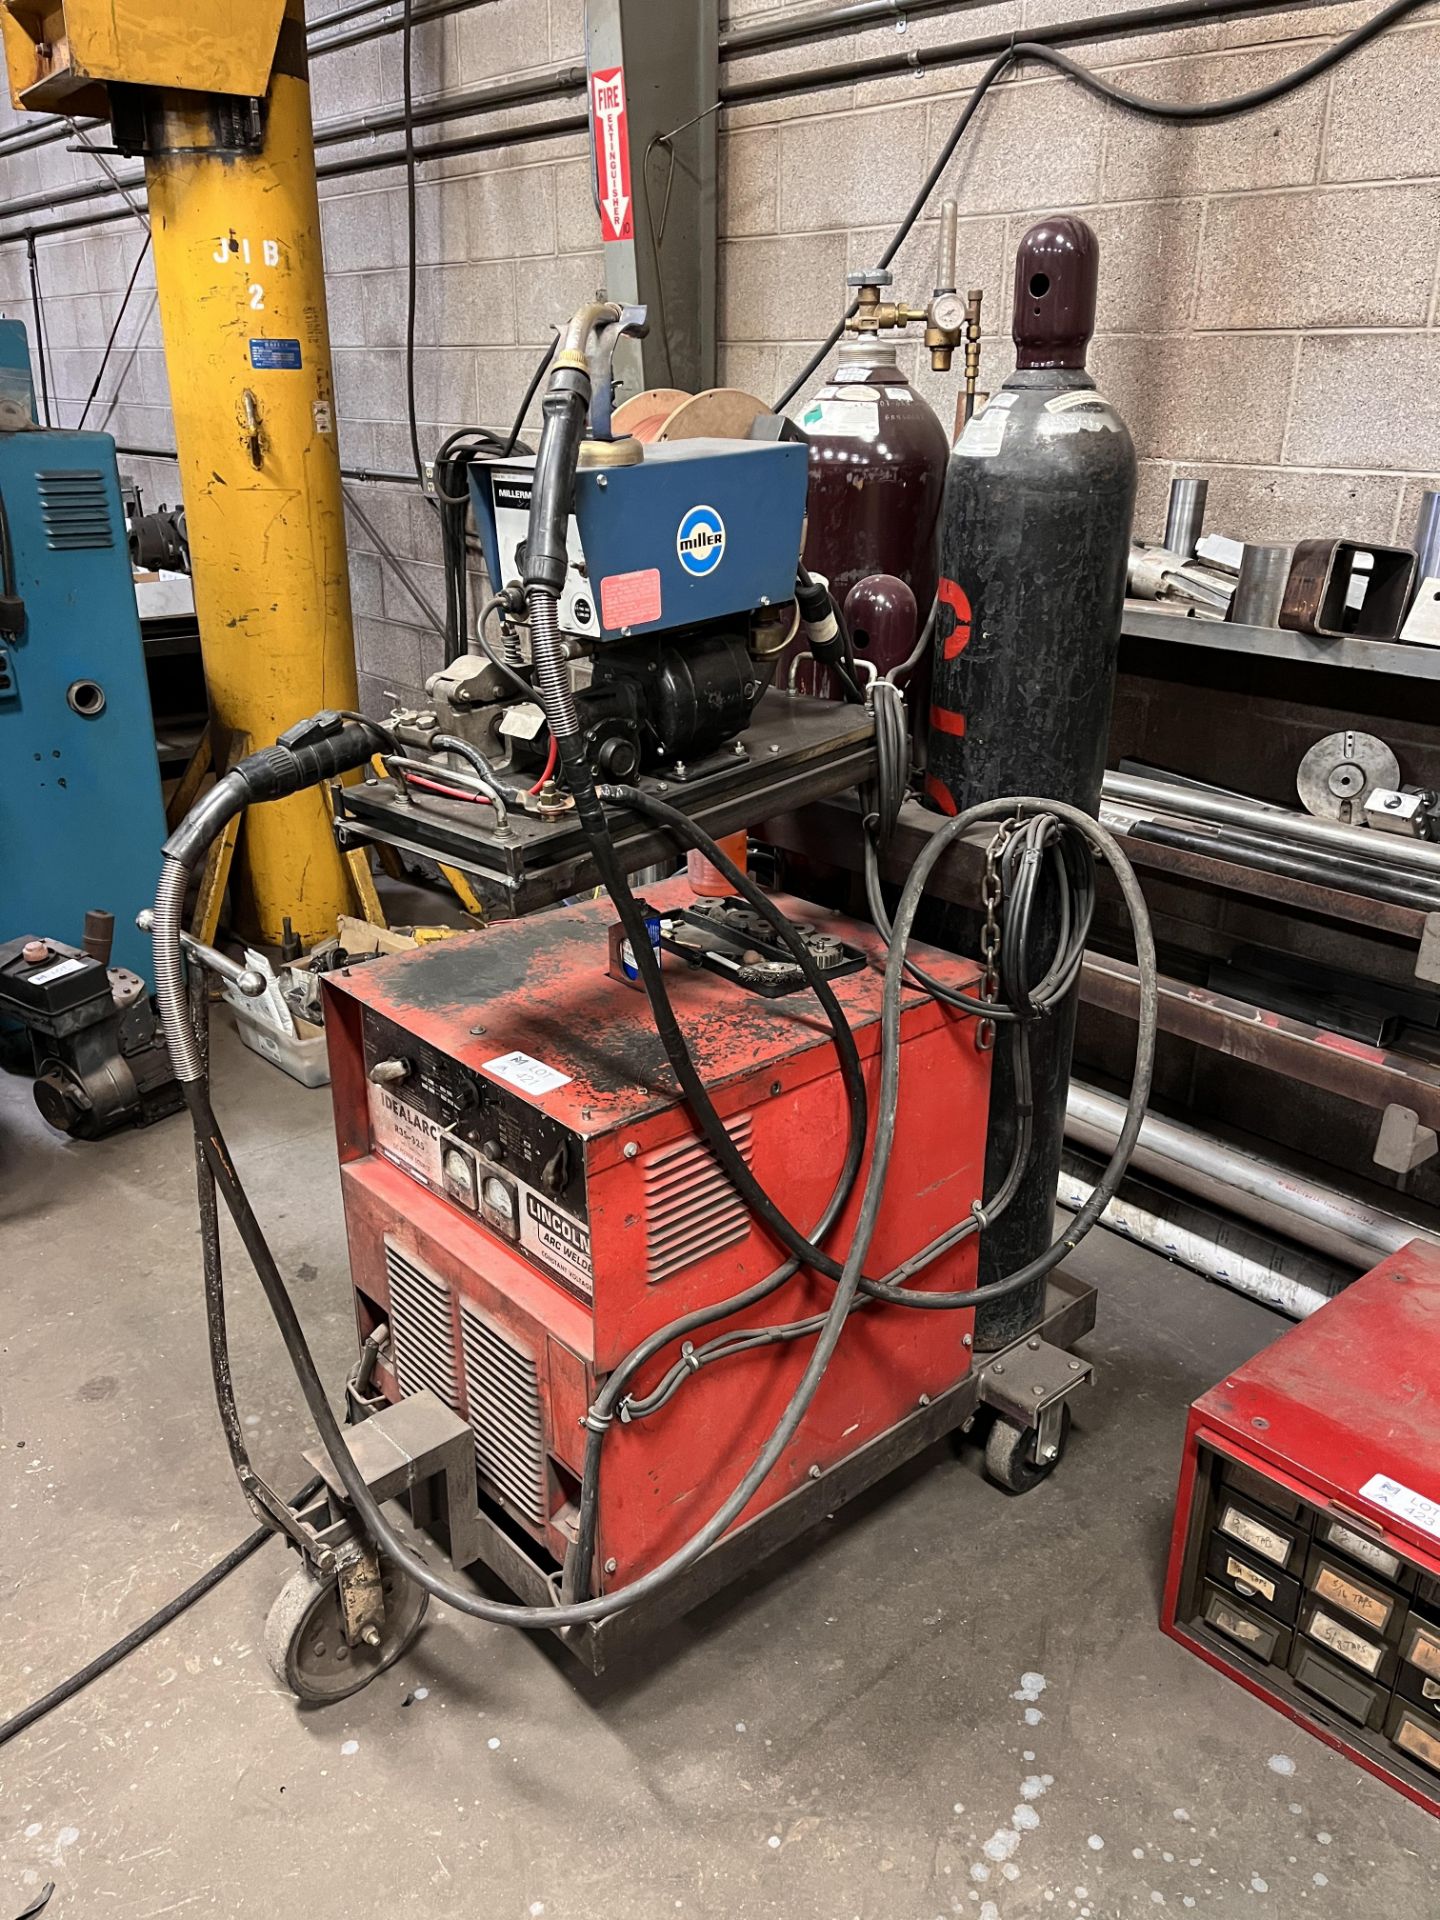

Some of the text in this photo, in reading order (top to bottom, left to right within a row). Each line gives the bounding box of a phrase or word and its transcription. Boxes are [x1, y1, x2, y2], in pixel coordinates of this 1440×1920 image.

[597, 85, 620, 111] FIRE
[607, 113, 621, 225] EXTINGUISHER
[248, 283, 265, 310] 2
[498, 488, 532, 500] MILLERM
[528, 1065, 555, 1079] LOT
[381, 1092, 438, 1141] IDEALARC
[528, 1197, 590, 1254] LINCOLN
[541, 1250, 568, 1273] CONSTANT
[543, 1232, 593, 1273] ARC WELDE
[1404, 1507, 1436, 1527] 423
[1410, 1496, 1440, 1516] LOT
[1351, 1592, 1374, 1609] TAPS
